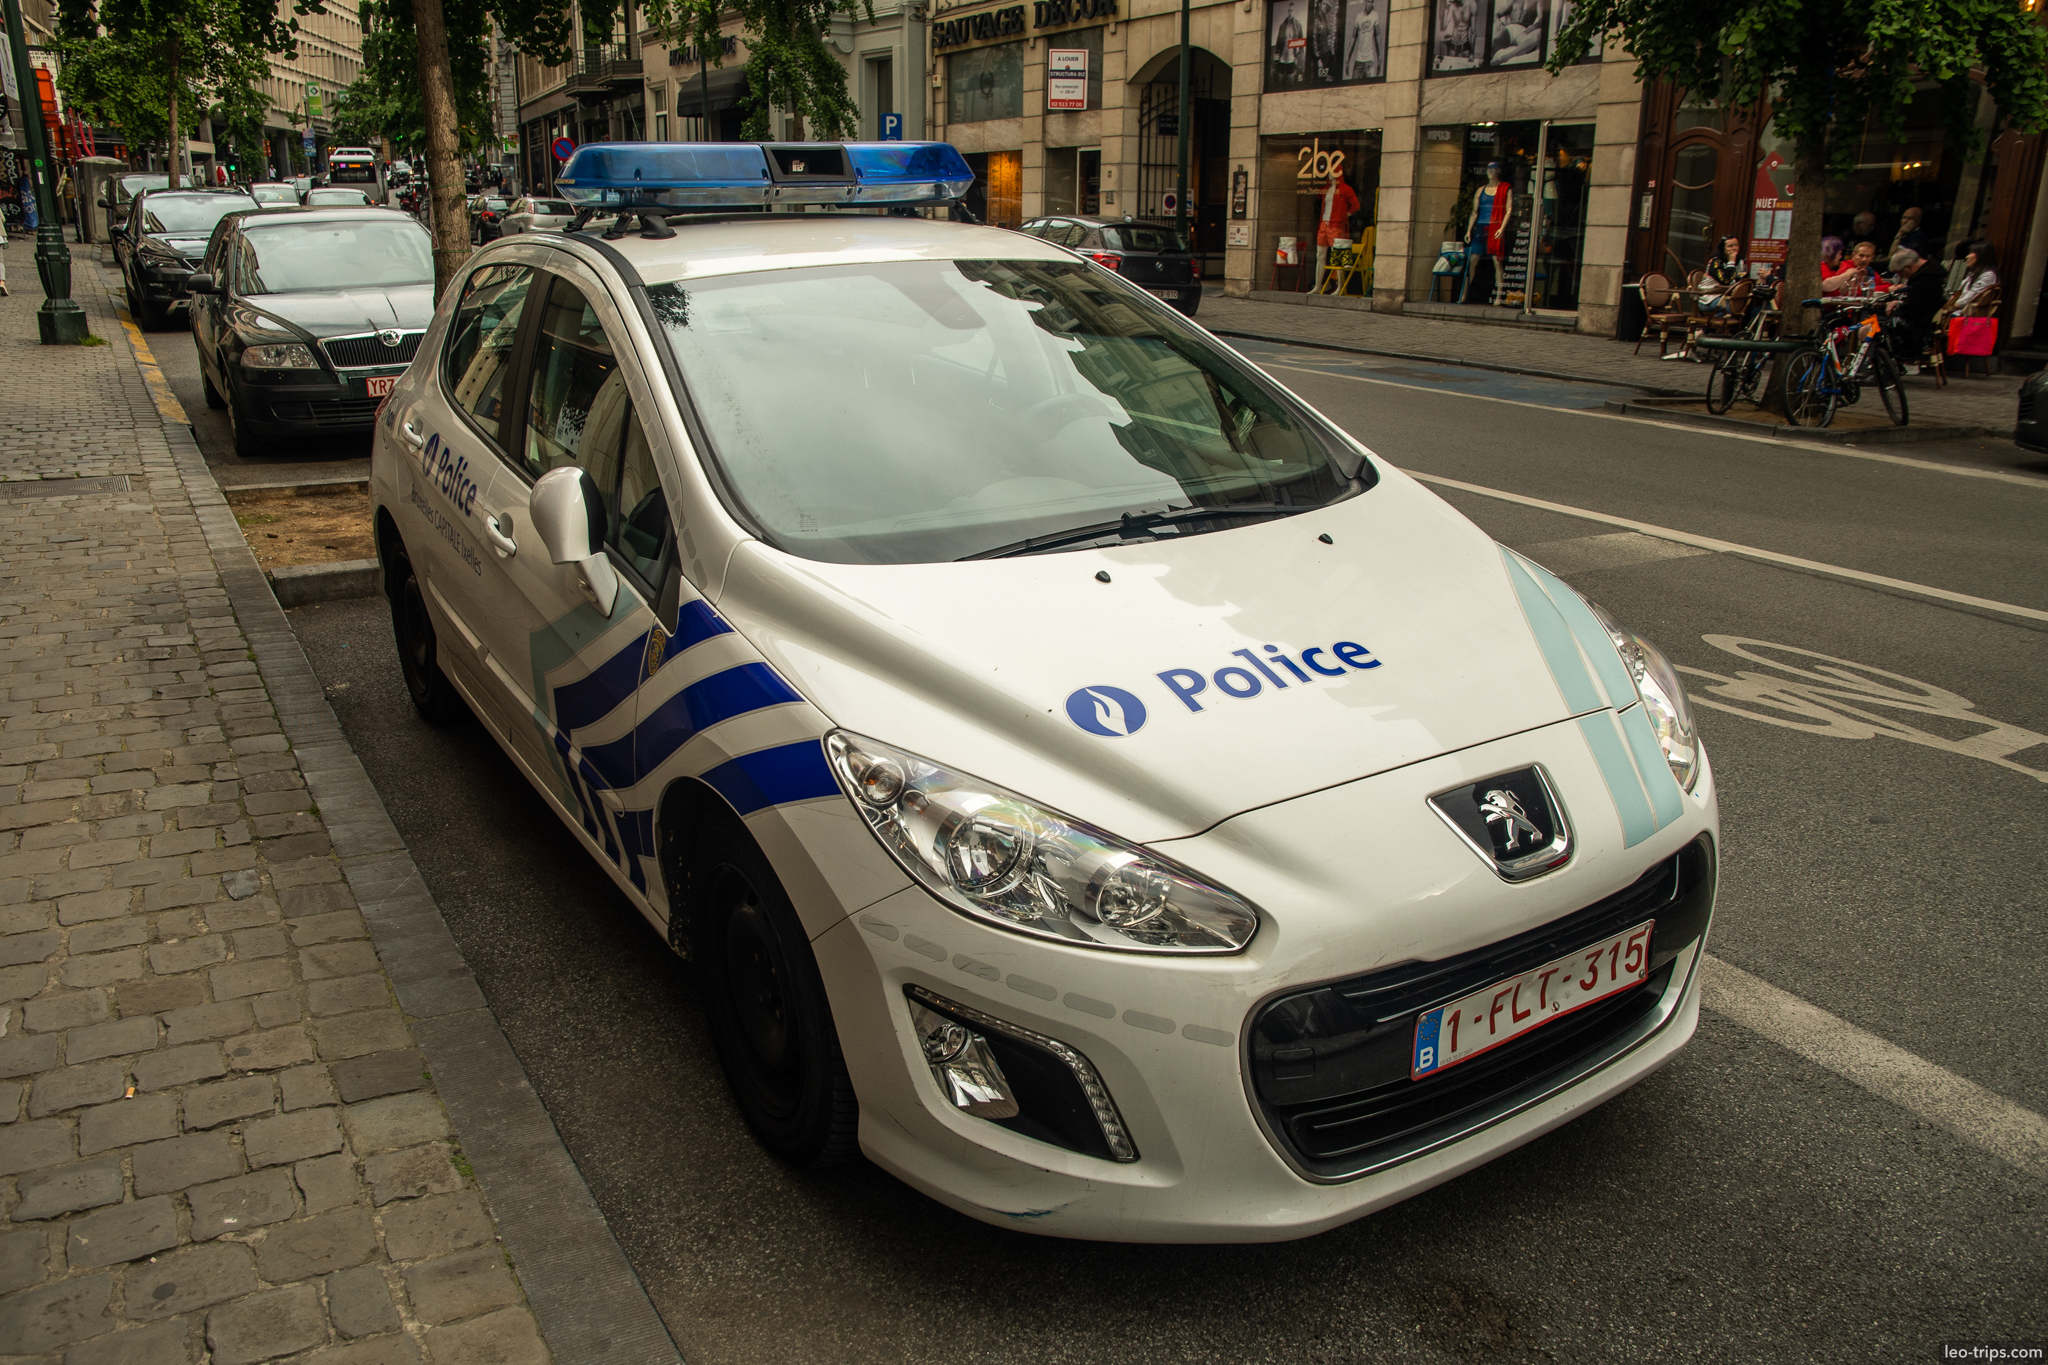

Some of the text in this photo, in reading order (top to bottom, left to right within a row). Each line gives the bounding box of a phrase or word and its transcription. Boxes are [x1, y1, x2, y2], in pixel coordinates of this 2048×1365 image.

[932, 5, 1024, 48] SAUVAGE
[1318, 68, 1329, 76] EA7
[886, 116, 897, 135] P
[1297, 138, 1345, 178] 2be
[435, 447, 477, 517] Police
[434, 509, 461, 554] CAPITALE
[461, 537, 482, 576] Ixelles
[1156, 641, 1382, 713] Police
[1447, 930, 1647, 1054] 1-FLT-315
[1420, 1046, 1434, 1069] B
